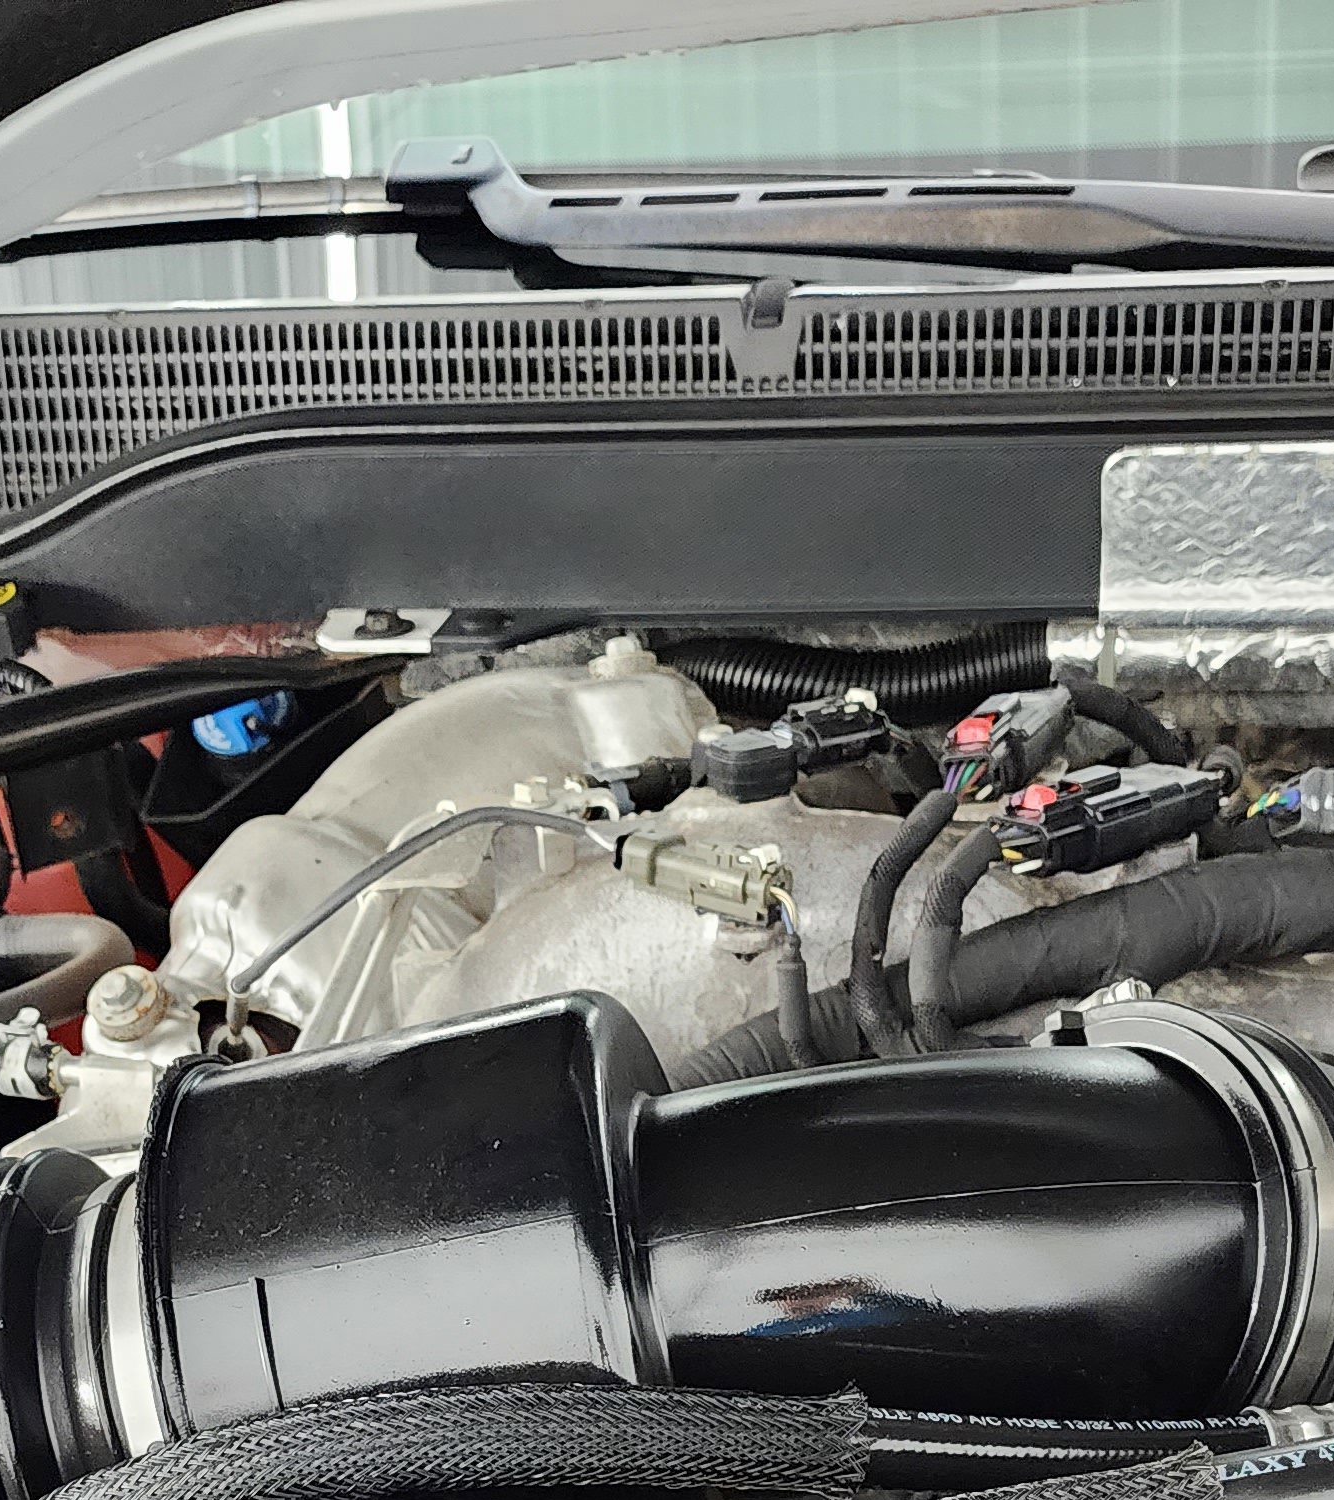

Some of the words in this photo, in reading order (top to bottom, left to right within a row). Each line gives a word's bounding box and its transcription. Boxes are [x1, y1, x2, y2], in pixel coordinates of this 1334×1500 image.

[970, 1415, 1002, 1427] A/C
[1006, 1417, 1062, 1429] HOSE
[1065, 1418, 1114, 1431] 13/32
[1116, 1419, 1134, 1431] in
[1137, 1418, 1204, 1431] (10mm)
